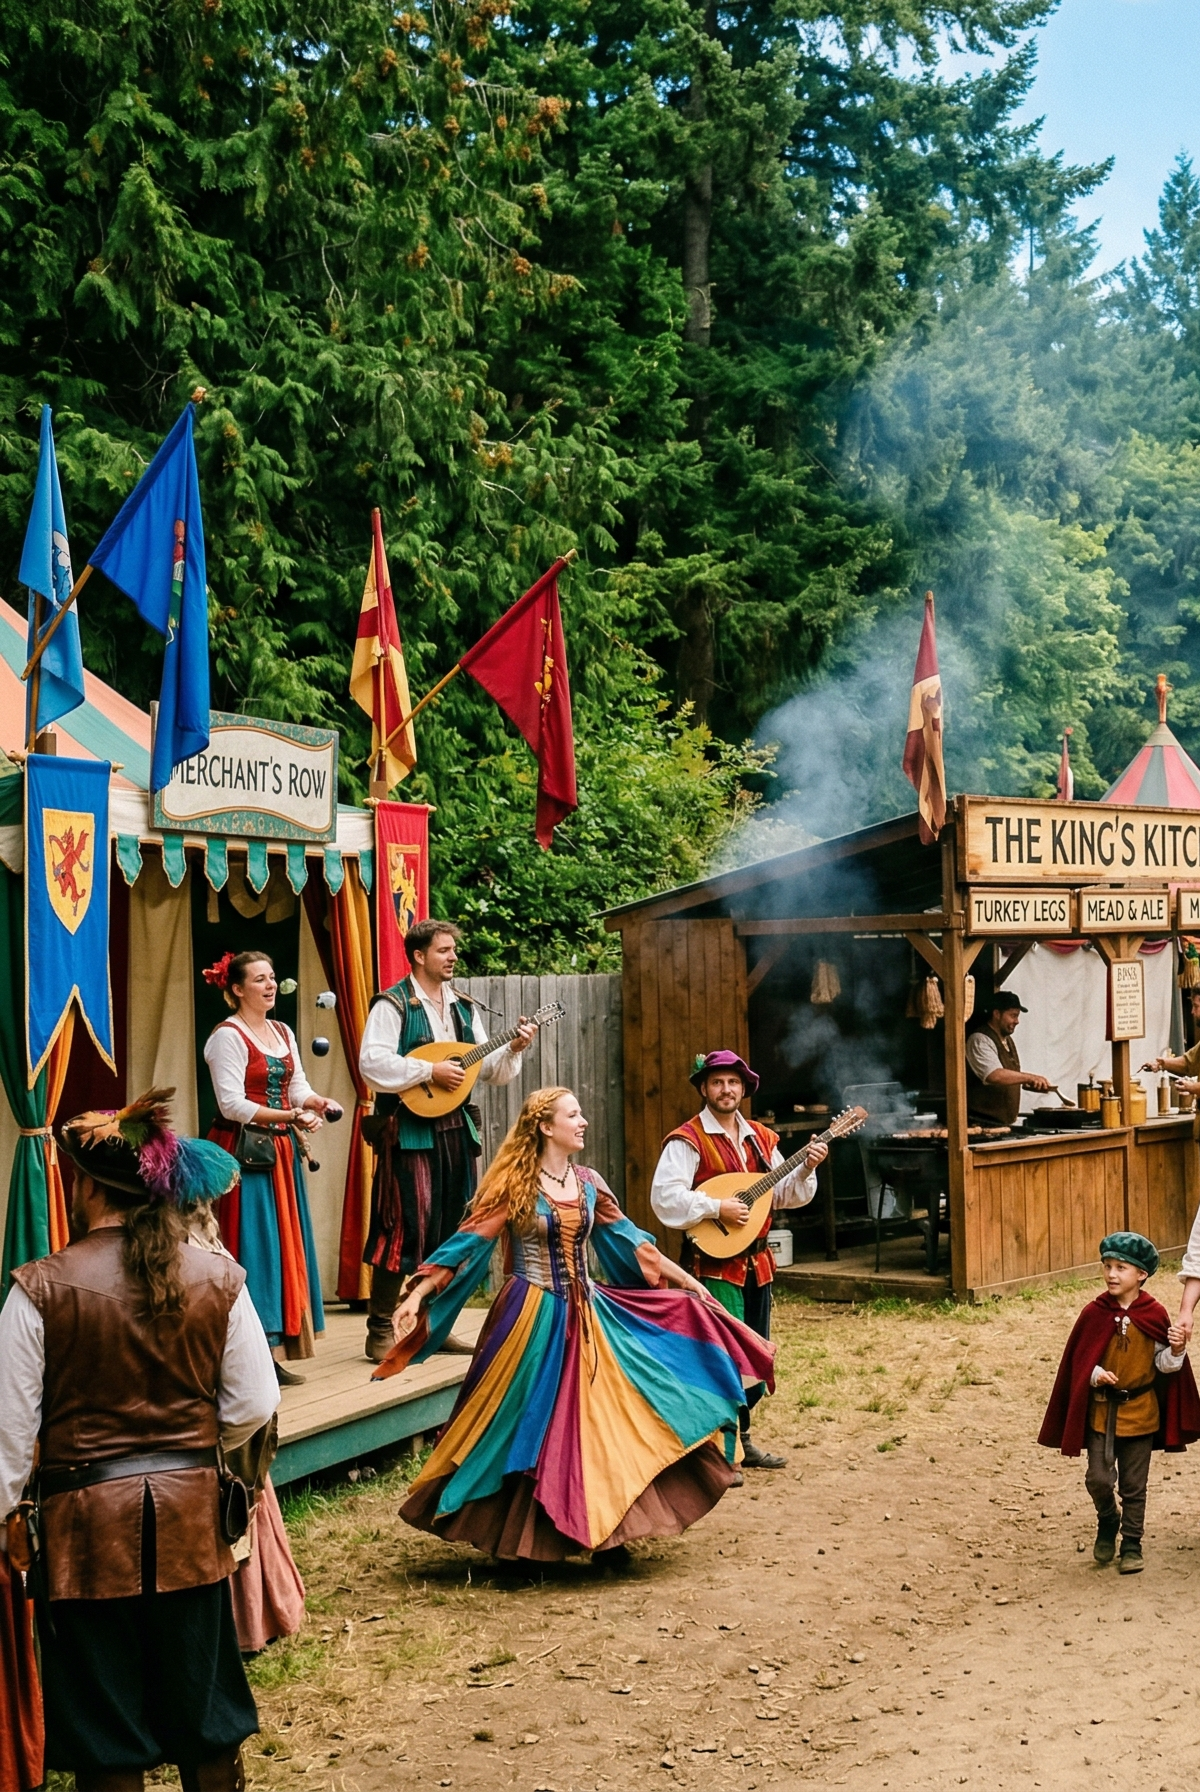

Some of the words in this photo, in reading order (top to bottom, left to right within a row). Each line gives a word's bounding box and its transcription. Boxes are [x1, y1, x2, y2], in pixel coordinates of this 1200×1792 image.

[288, 762, 327, 800] ROW
[984, 816, 1043, 865] THE
[1051, 814, 1136, 867] KING'S
[974, 899, 1029, 923] TURKEY
[1033, 899, 1067, 923] LEGS
[1087, 899, 1125, 922] MEAD
[1128, 900, 1138, 920] &
[1140, 898, 1164, 921] ALE
